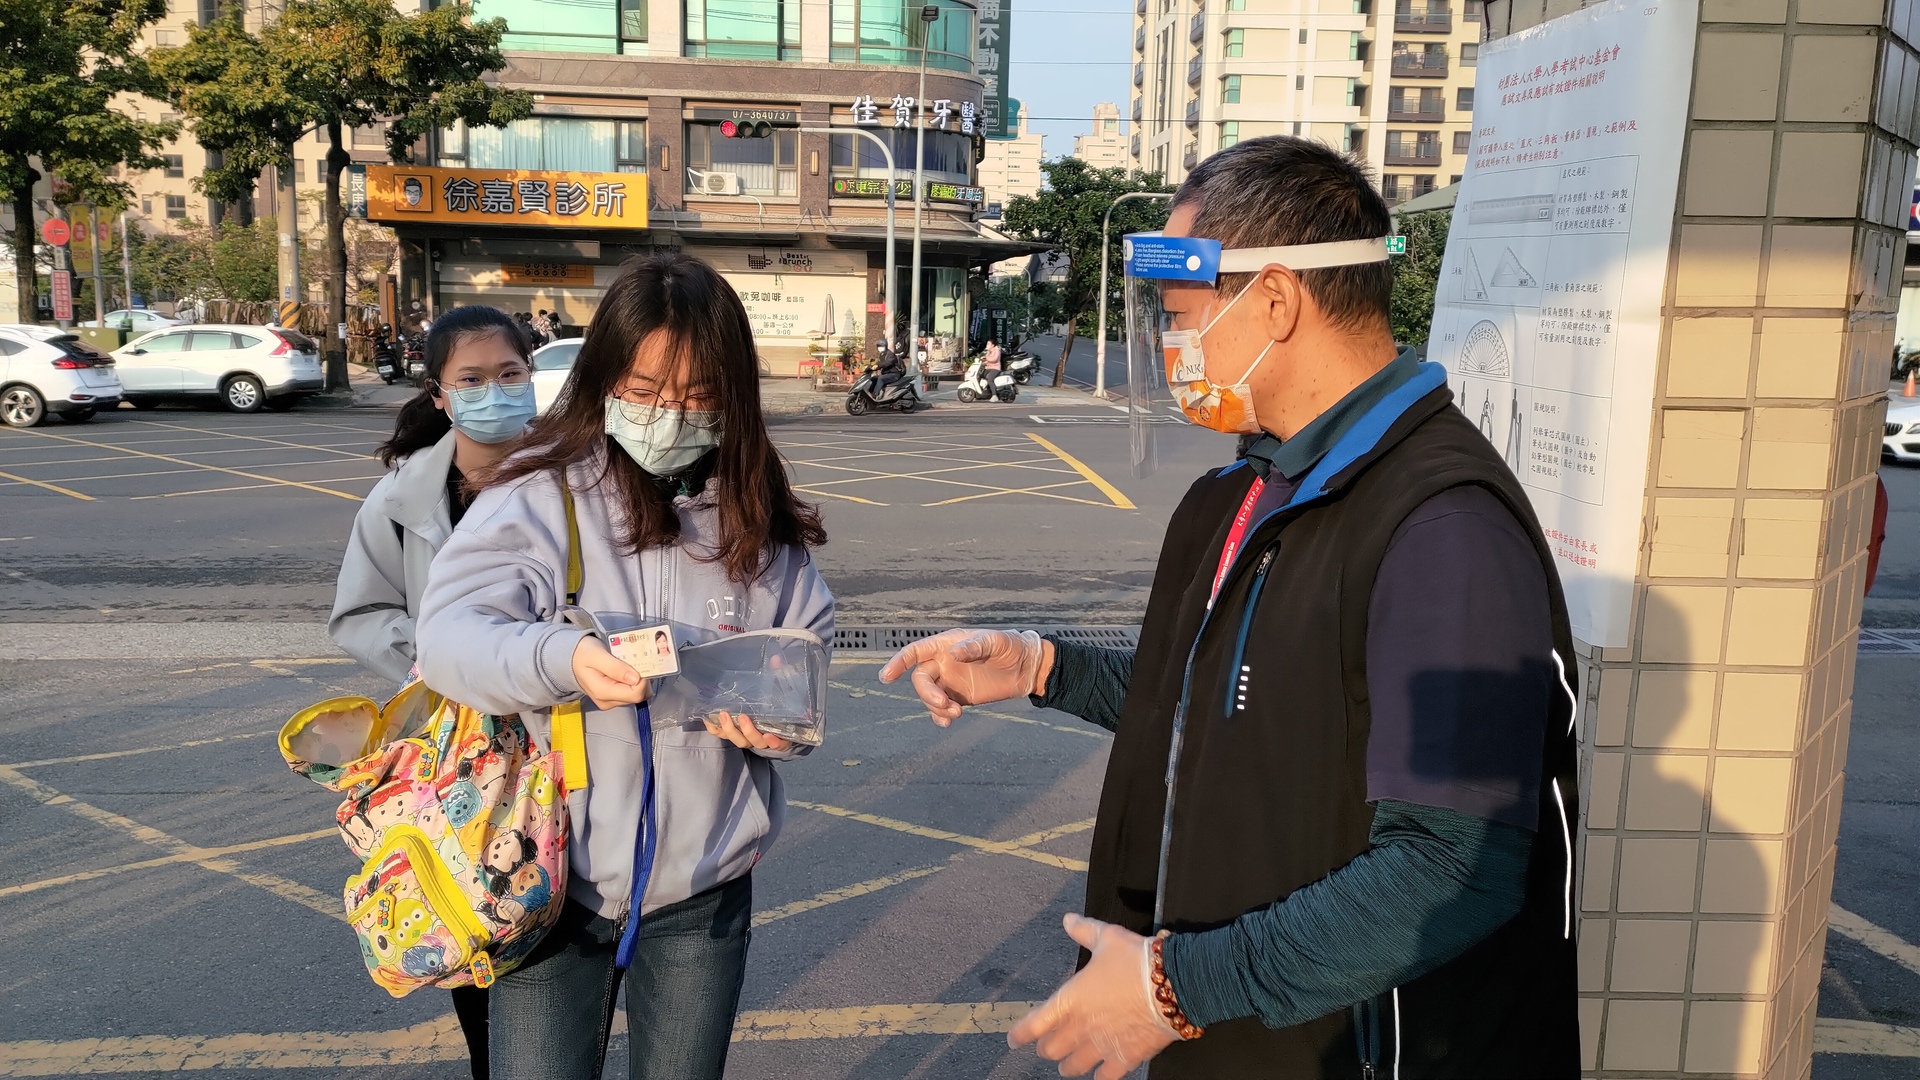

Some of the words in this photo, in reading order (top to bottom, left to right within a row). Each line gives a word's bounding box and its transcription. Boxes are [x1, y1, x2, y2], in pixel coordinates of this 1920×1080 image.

[1643, 7, 1658, 16] C07
[732, 110, 791, 120] 07-3640737
[442, 176, 627, 218] 徐嘉賢診所
